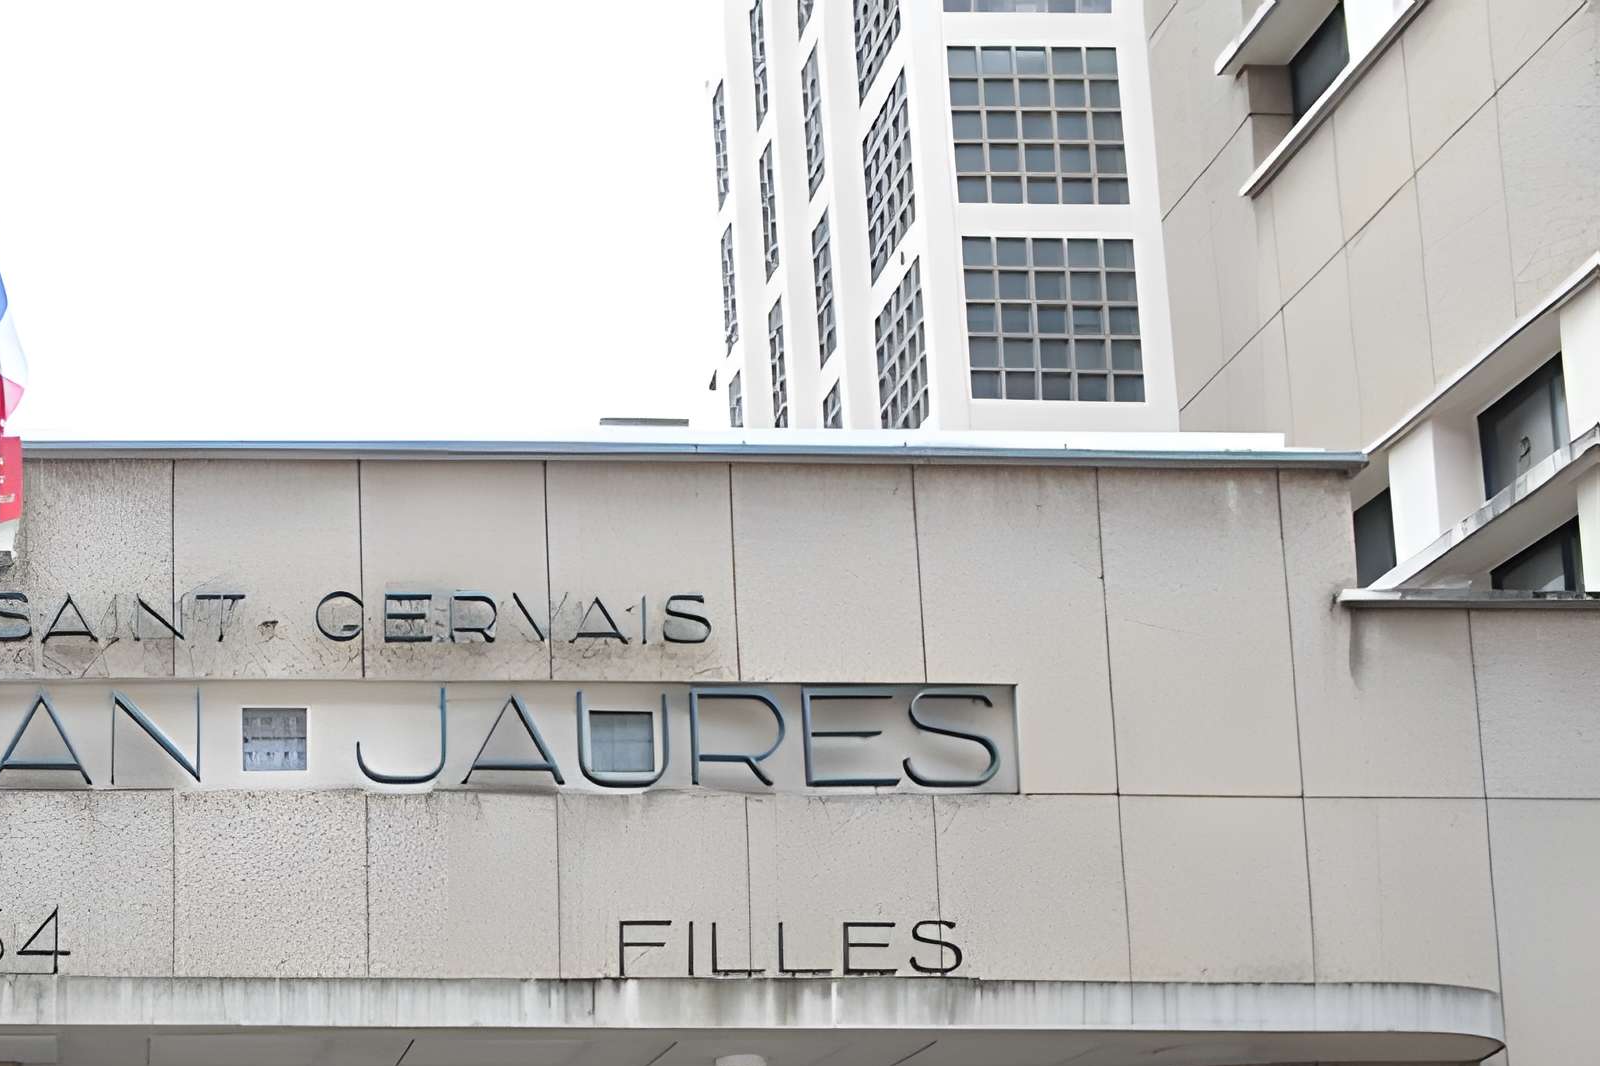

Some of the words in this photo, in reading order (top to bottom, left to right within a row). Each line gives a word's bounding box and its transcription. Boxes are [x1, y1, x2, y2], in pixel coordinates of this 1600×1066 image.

[315, 590, 712, 644] GERVAIS
[357, 686, 1002, 789] JAURES
[618, 919, 963, 977] FILLES
